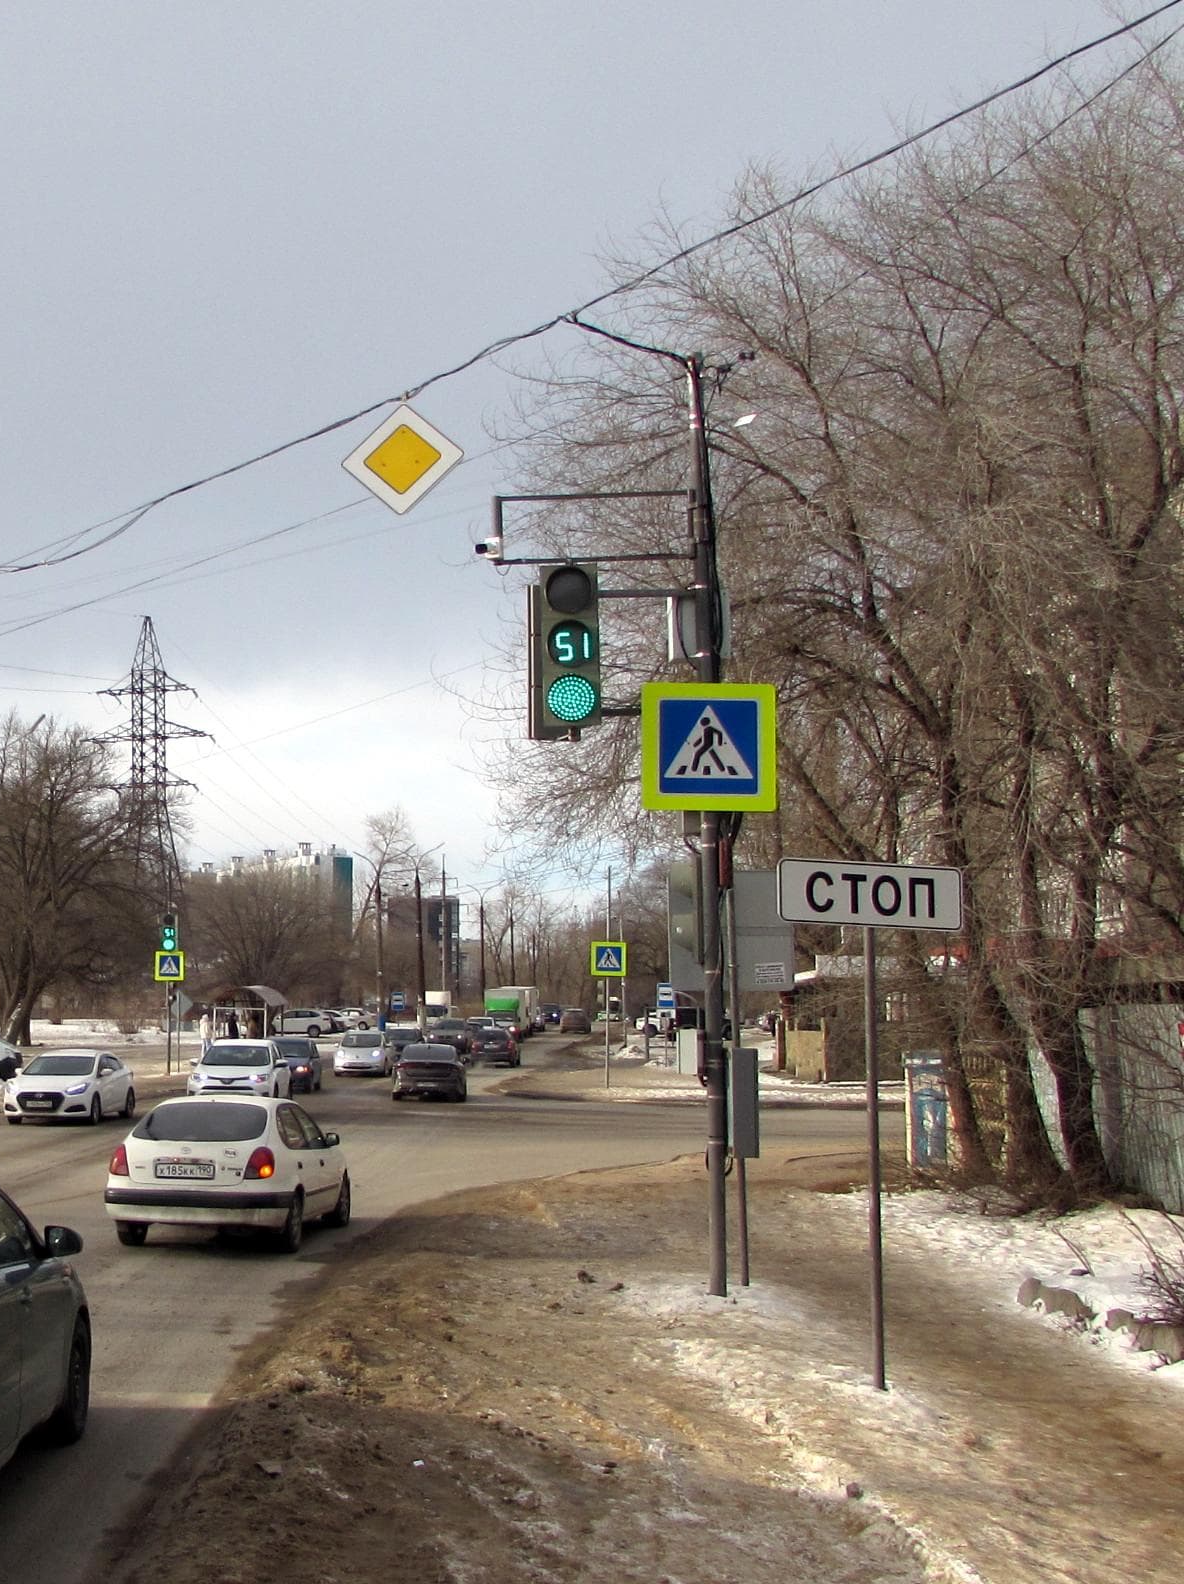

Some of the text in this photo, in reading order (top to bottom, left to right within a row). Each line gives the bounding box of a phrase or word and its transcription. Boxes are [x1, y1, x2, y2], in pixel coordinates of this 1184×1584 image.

[555, 632, 590, 661] 51
[805, 870, 936, 919] СТОП
[164, 928, 174, 937] 51
